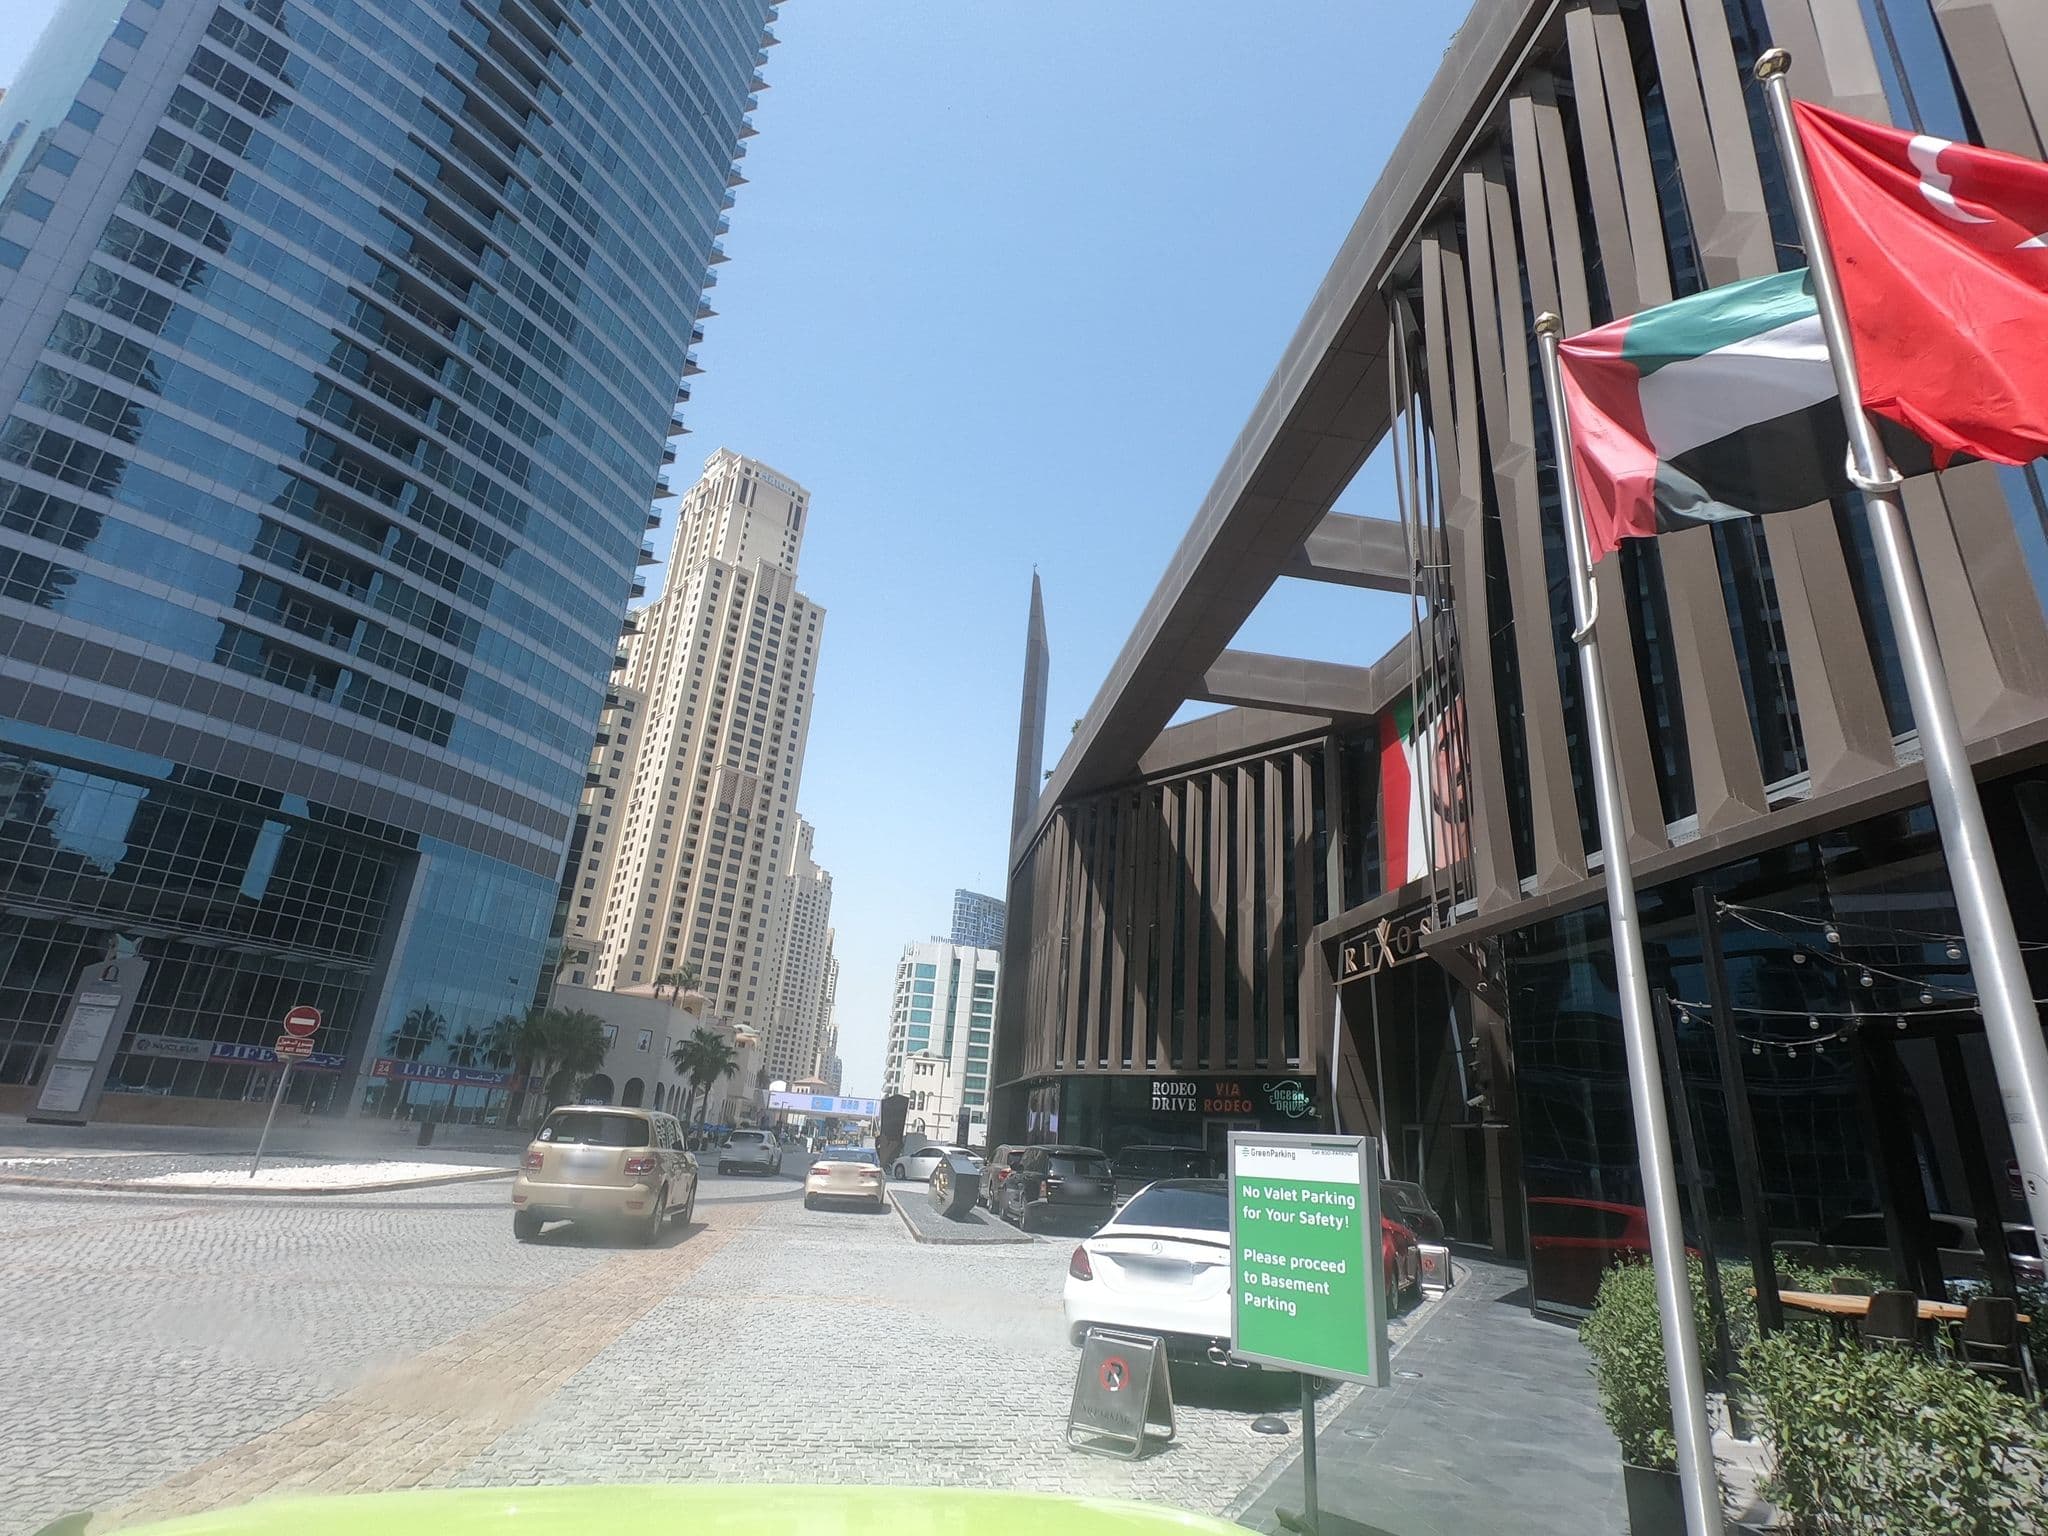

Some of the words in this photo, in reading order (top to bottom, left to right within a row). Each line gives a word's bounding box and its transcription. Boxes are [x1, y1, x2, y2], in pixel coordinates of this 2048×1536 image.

[214, 1044, 274, 1062] LIFE
[378, 1064, 390, 1073] 24
[403, 1063, 447, 1079] LIFE
[1152, 1081, 1197, 1096] RODEO
[1215, 1082, 1241, 1096] VIA
[1152, 1097, 1197, 1112] DRIVE
[1203, 1099, 1252, 1113] RODEO
[1250, 1149, 1296, 1160] GreenParking
[1242, 1185, 1260, 1198] No
[1263, 1186, 1298, 1201] Valet
[1302, 1189, 1356, 1210] Parking
[1243, 1206, 1261, 1219] for
[1266, 1208, 1295, 1223] Your
[1299, 1211, 1349, 1231] Safety!
[1243, 1248, 1286, 1266] Please
[1290, 1257, 1346, 1274] proceed
[1243, 1270, 1258, 1284] to
[1261, 1273, 1330, 1295] Basement
[1244, 1292, 1297, 1317] Parking
